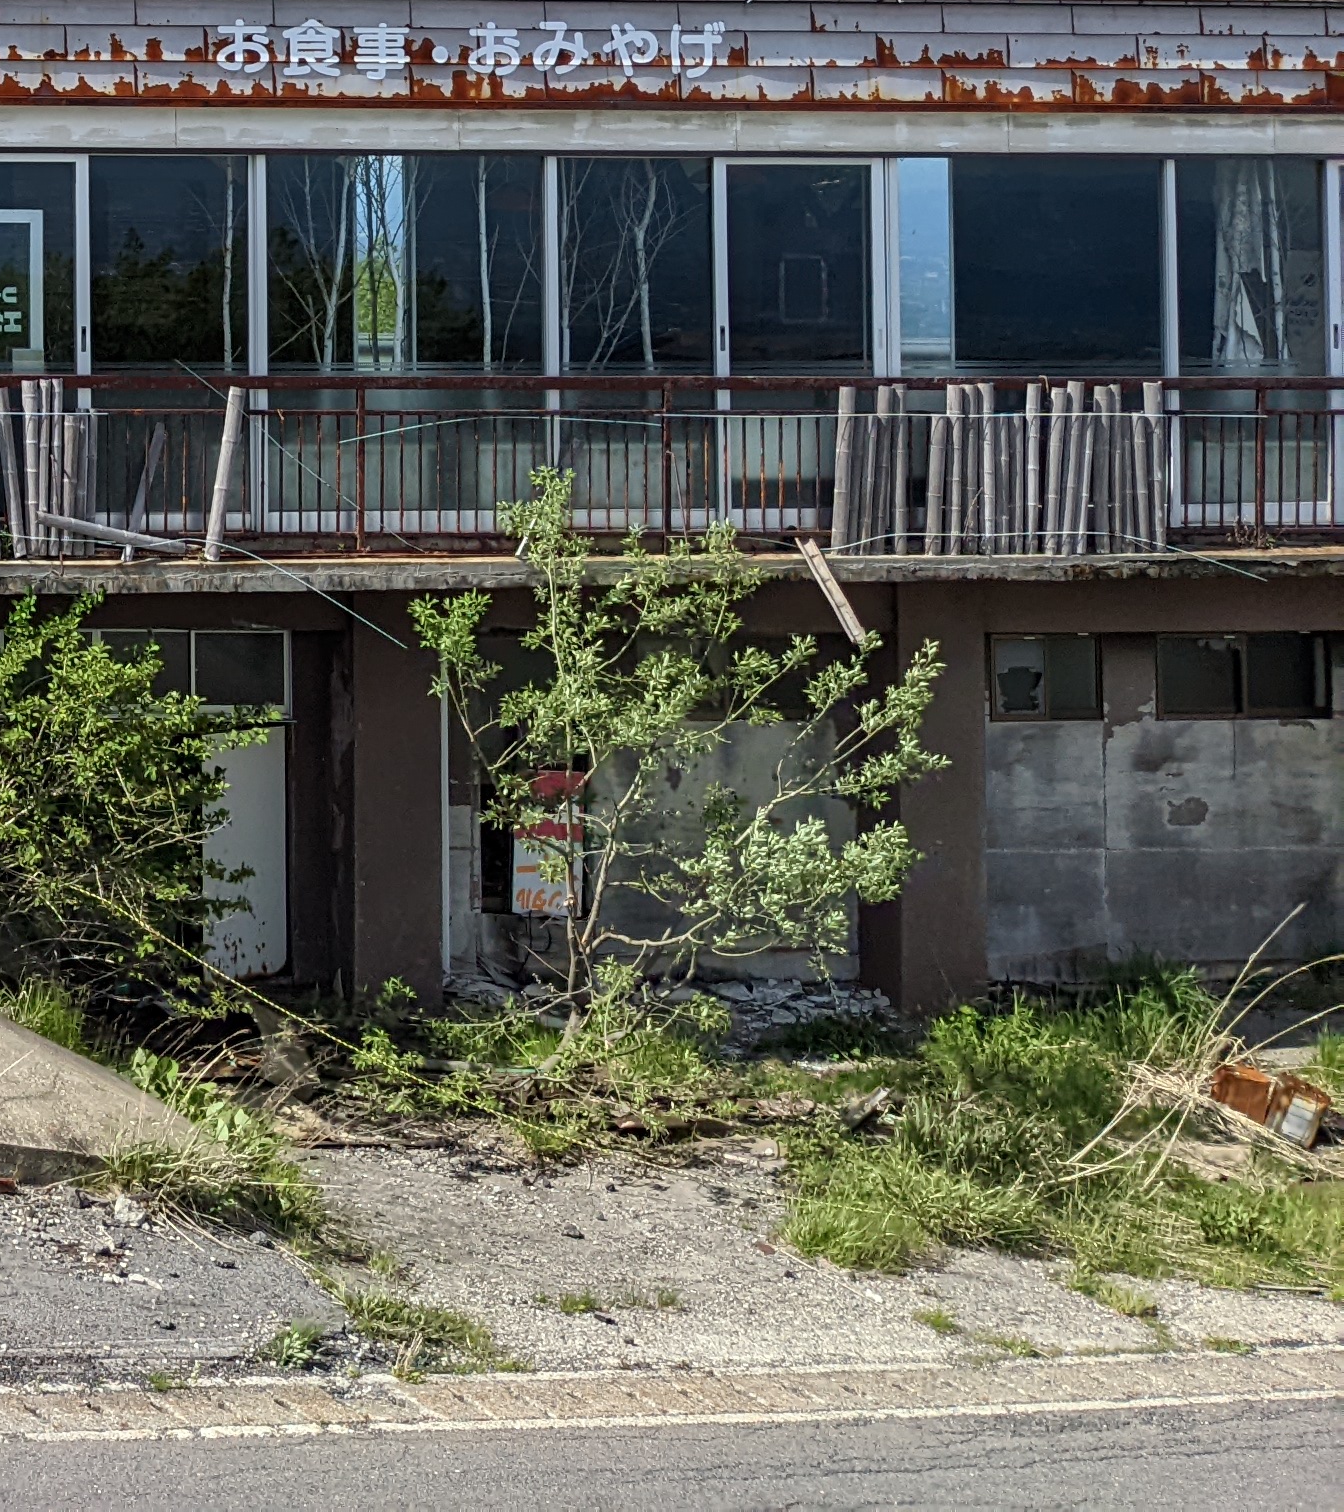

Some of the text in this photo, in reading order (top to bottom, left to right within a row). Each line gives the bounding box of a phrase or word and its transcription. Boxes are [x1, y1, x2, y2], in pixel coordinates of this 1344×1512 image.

[215, 19, 727, 81] お食事・おみやげ
